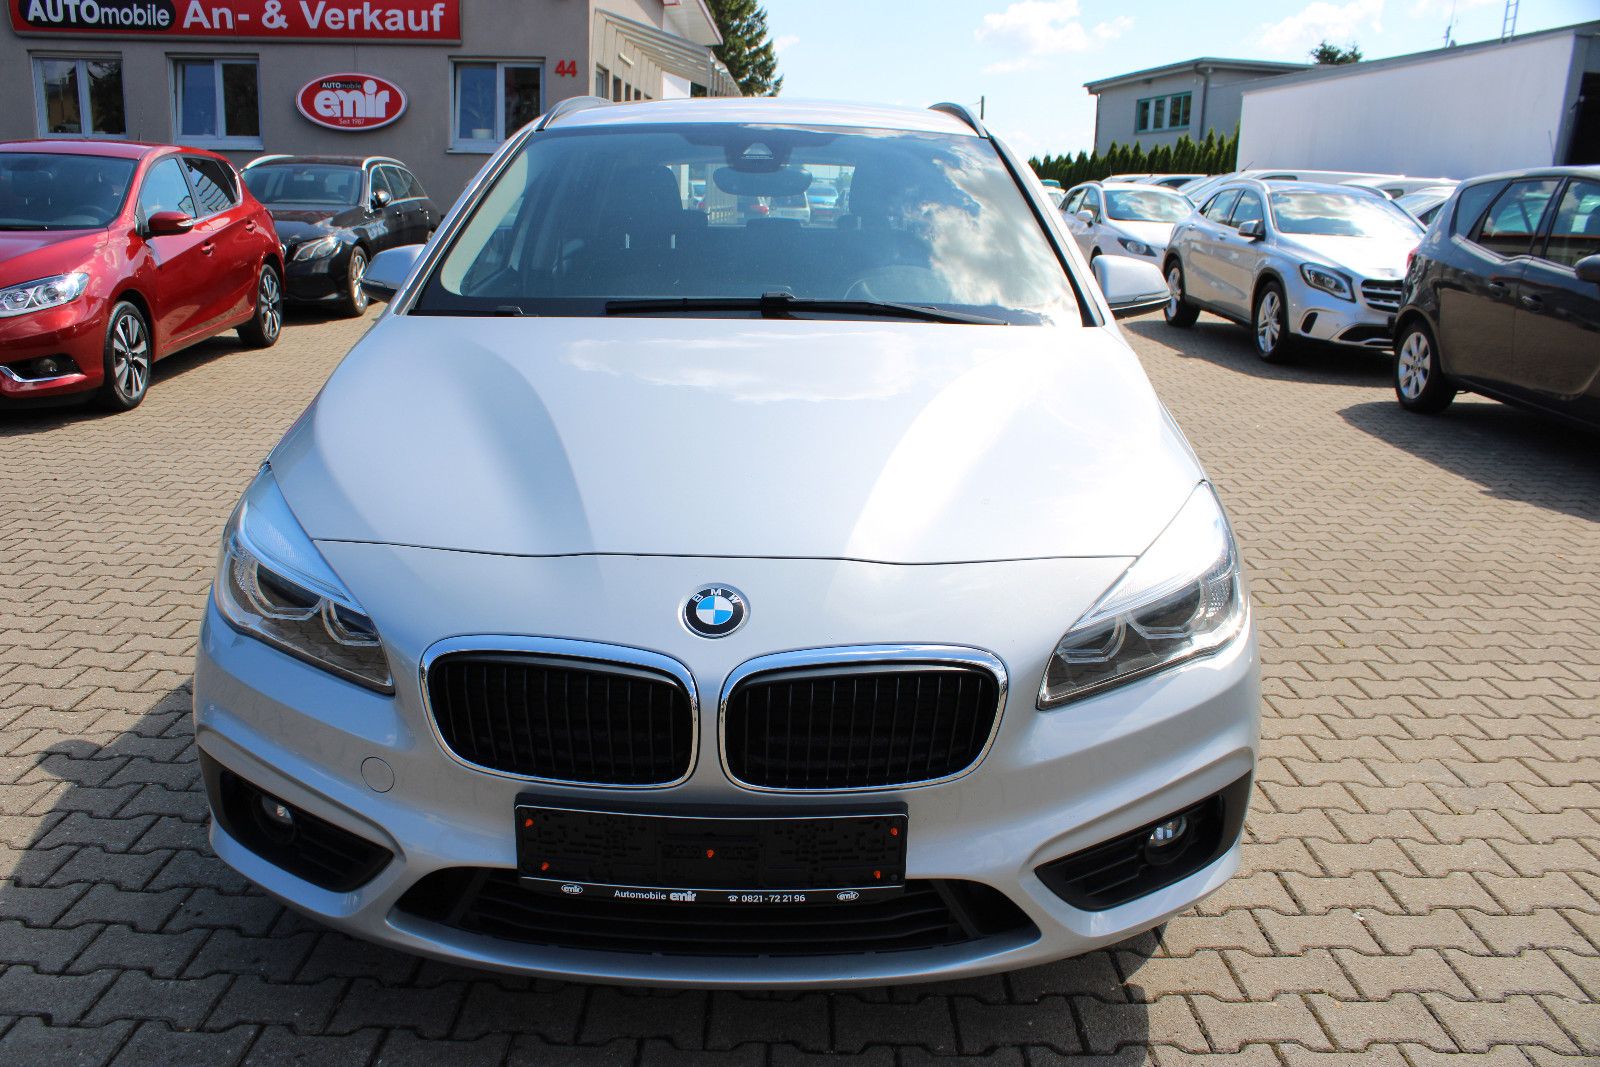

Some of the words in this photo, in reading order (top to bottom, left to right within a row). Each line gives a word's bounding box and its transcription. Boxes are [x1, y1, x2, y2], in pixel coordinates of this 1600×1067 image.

[182, 0, 250, 30] An-
[261, 0, 288, 30] &
[300, 1, 445, 32] Verkauf
[554, 60, 577, 77] 44
[314, 80, 390, 118] emir
[691, 588, 742, 604] BMW
[613, 890, 667, 900] Automobile
[669, 890, 697, 902] emir
